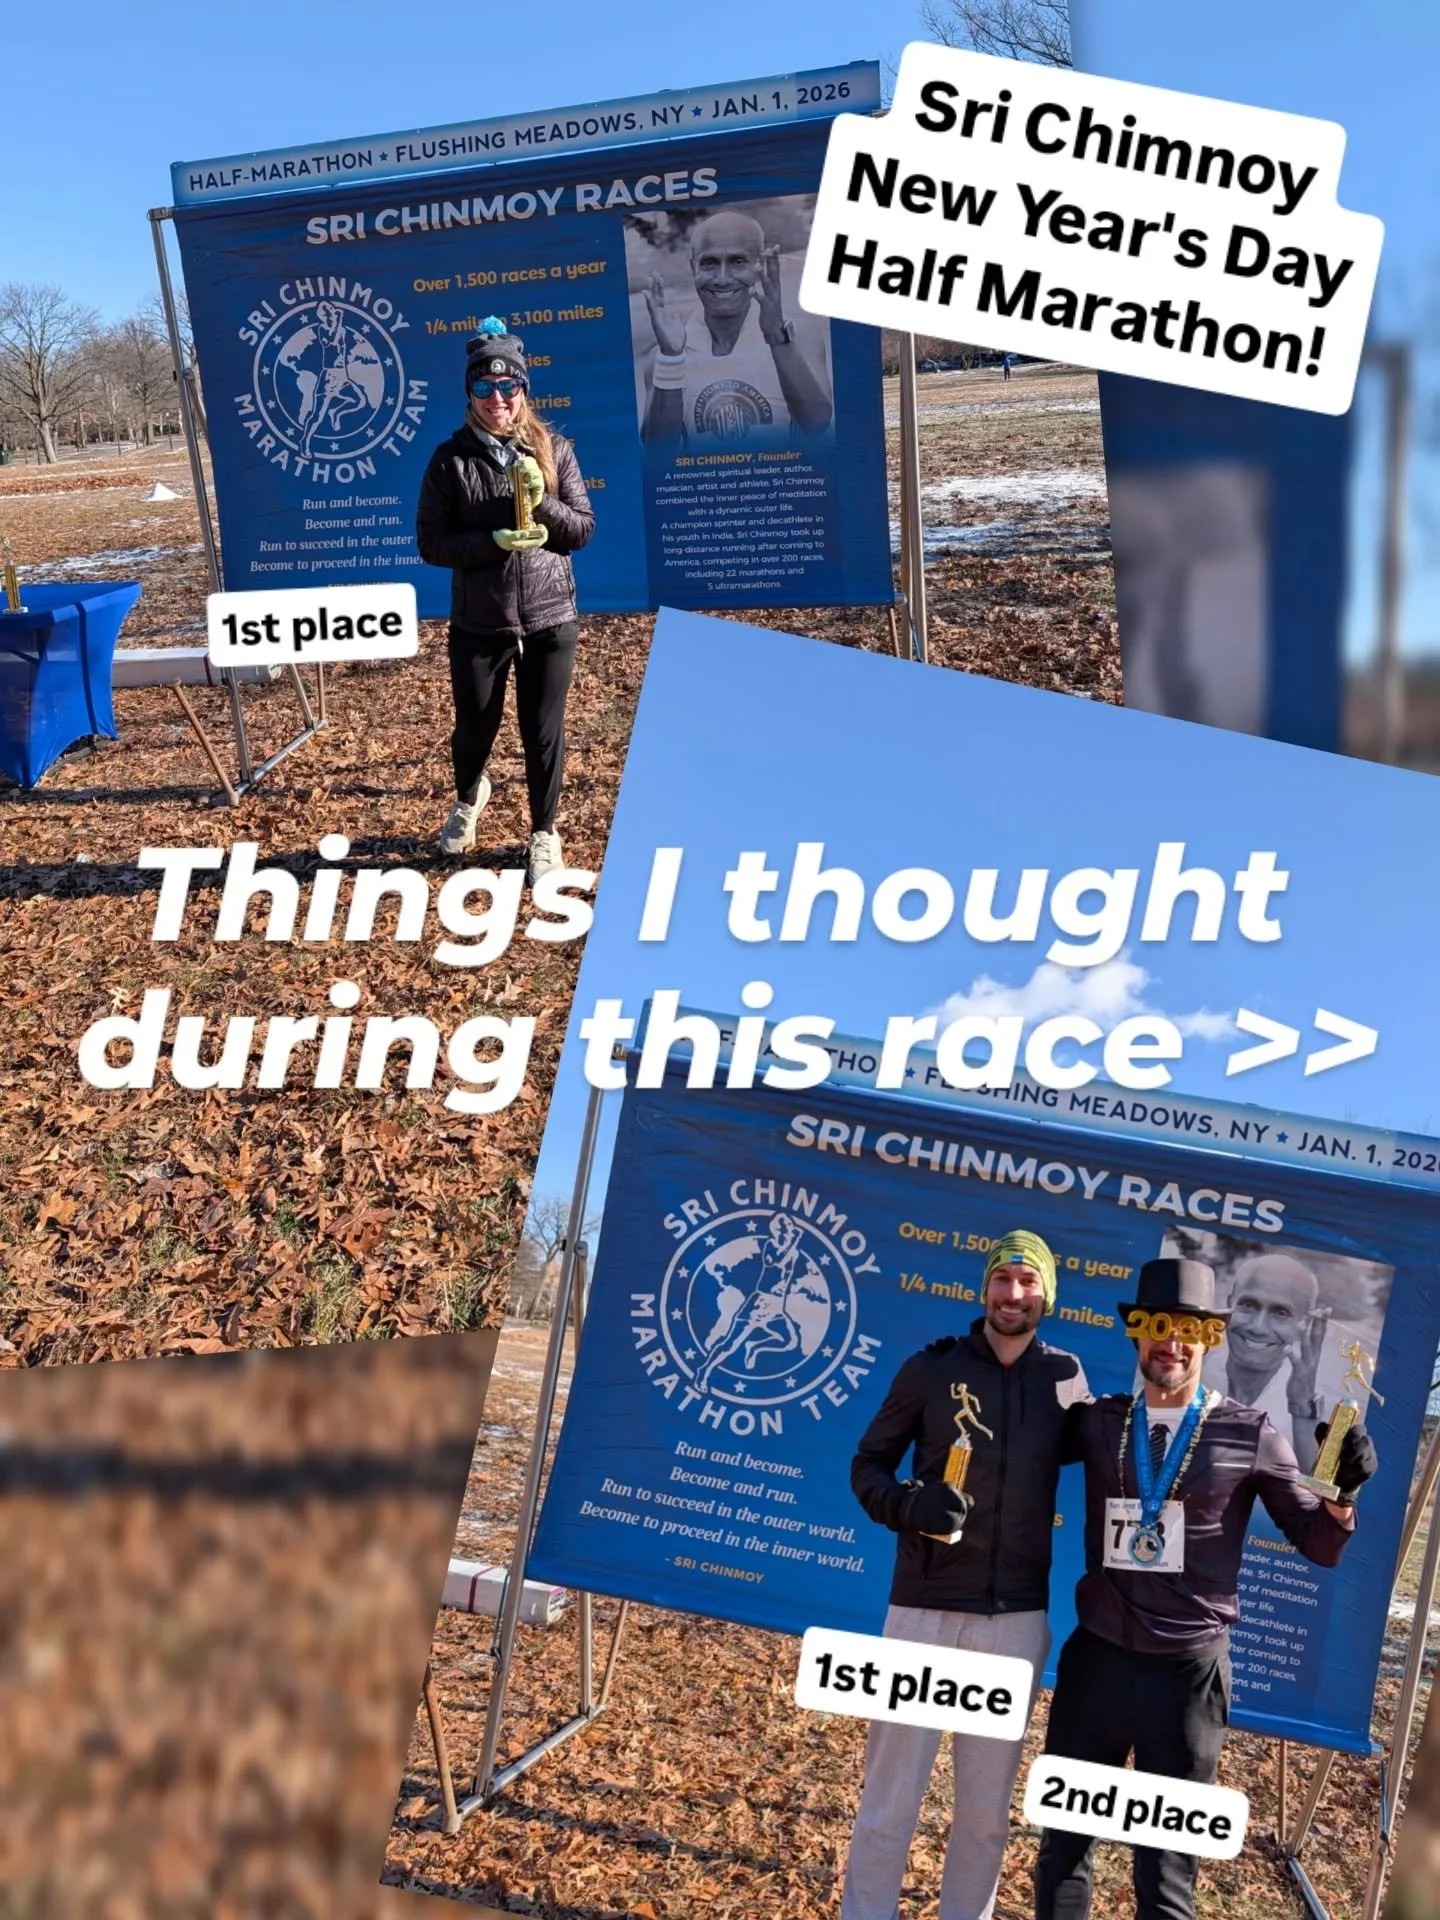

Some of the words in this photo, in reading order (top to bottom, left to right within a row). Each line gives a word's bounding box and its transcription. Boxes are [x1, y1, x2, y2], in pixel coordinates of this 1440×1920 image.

[189, 149, 372, 191] HALF-MARATHON
[395, 131, 505, 162] FLUSHING
[514, 112, 643, 145] MEADOWS,
[651, 104, 684, 126] NY
[711, 94, 764, 118] JAN.
[771, 91, 788, 110] 1,
[796, 81, 850, 104] 2026
[306, 211, 366, 244] SRI
[374, 186, 564, 235] CHINMOY
[575, 167, 717, 212] RACES
[412, 278, 450, 292] Over
[454, 270, 497, 288] 1,500
[501, 267, 547, 283] races
[550, 266, 561, 277] a
[566, 261, 606, 279] year
[239, 300, 277, 346] SRI
[279, 276, 411, 333] CHINMOY
[425, 318, 448, 335] 1/4
[452, 316, 480, 332] mil
[510, 309, 553, 325] 3,100
[557, 304, 604, 321] miles
[234, 394, 376, 484] MARATHON
[382, 379, 429, 457] TEAM
[675, 457, 694, 466] SRI
[696, 453, 754, 464] CHINMOY,
[758, 451, 800, 461] Founder
[302, 498, 326, 509] Run
[329, 495, 352, 507] and
[355, 495, 401, 506] become.
[687, 507, 706, 515] with
[715, 505, 752, 515] dynamic
[305, 518, 350, 529] Become
[353, 514, 375, 526] and
[378, 516, 402, 525] run.
[669, 521, 712, 529] champion
[713, 519, 746, 528] sprinter
[748, 517, 764, 525] and
[766, 515, 813, 524] decathlete
[259, 540, 281, 551] Run
[285, 541, 296, 550] to
[299, 536, 344, 549] succeed
[346, 536, 358, 547] in
[361, 535, 379, 546] the
[381, 535, 413, 545] outer
[675, 533, 700, 542] youth
[736, 530, 747, 538] Sri
[749, 530, 788, 538] Chinmoy
[790, 527, 810, 536] took
[250, 560, 294, 571] Become
[297, 560, 308, 569] to
[311, 555, 356, 573] proceed
[359, 555, 370, 566] in
[373, 554, 391, 566] the
[685, 570, 724, 578] including
[738, 567, 785, 576] marathons
[786, 566, 804, 574] and
[715, 580, 781, 589] ultramarathons.
[924, 1066, 1059, 1107] FLHING
[1069, 1092, 1218, 1136] MEADOWS,
[1229, 1120, 1269, 1143] NY
[1297, 1131, 1355, 1160] JAN.
[1366, 1143, 1381, 1166] 1,
[1392, 1148, 1440, 1172] 202
[786, 1114, 865, 1156] SRI
[875, 1131, 1109, 1199] CHINMOY
[1117, 1174, 1285, 1232] RACES
[663, 1190, 719, 1239] SRI
[730, 1179, 881, 1275] CHINMOY
[898, 1222, 946, 1244] Over
[1065, 1256, 1080, 1270] a
[1084, 1259, 1133, 1279] year
[900, 1273, 926, 1292] 1/4
[930, 1281, 975, 1301] mile
[1059, 1306, 1114, 1328] miles
[1125, 1309, 1226, 1348] 2026
[630, 1293, 783, 1436] MARATHON
[801, 1334, 882, 1421] TEAM
[674, 1440, 706, 1459] Run
[709, 1451, 742, 1465] and
[743, 1453, 803, 1478] become.
[669, 1466, 730, 1490] Become
[733, 1482, 764, 1497] and
[765, 1488, 796, 1504] run.
[600, 1478, 632, 1496] Run
[635, 1487, 651, 1500] to
[653, 1492, 715, 1514] succeed
[716, 1502, 732, 1517] in
[735, 1506, 760, 1523] the
[762, 1515, 805, 1531] outer
[808, 1524, 854, 1543] world.
[579, 1500, 640, 1524] Become
[643, 1515, 659, 1528] to
[660, 1520, 723, 1542] proceed
[724, 1530, 740, 1546] in
[743, 1535, 768, 1552] the
[771, 1540, 814, 1561] inner
[817, 1553, 864, 1572] world.
[1247, 1535, 1296, 1553] Founder
[673, 1556, 696, 1568] SRI
[700, 1562, 763, 1583] CHINMOY
[1273, 1559, 1309, 1573] author,
[1257, 1569, 1270, 1579] Sri
[1272, 1573, 1319, 1592] Chinmoy
[1248, 1584, 1260, 1592] of
[1261, 1587, 1317, 1606] meditation
[1240, 1614, 1294, 1632] decathlete
[1297, 1625, 1307, 1636] in
[1264, 1634, 1287, 1646] took
[1289, 1642, 1304, 1651] up
[1247, 1648, 1287, 1664] coming
[1289, 1656, 1300, 1665] to
[1247, 1662, 1266, 1674] 200
[1250, 1681, 1270, 1691] and
